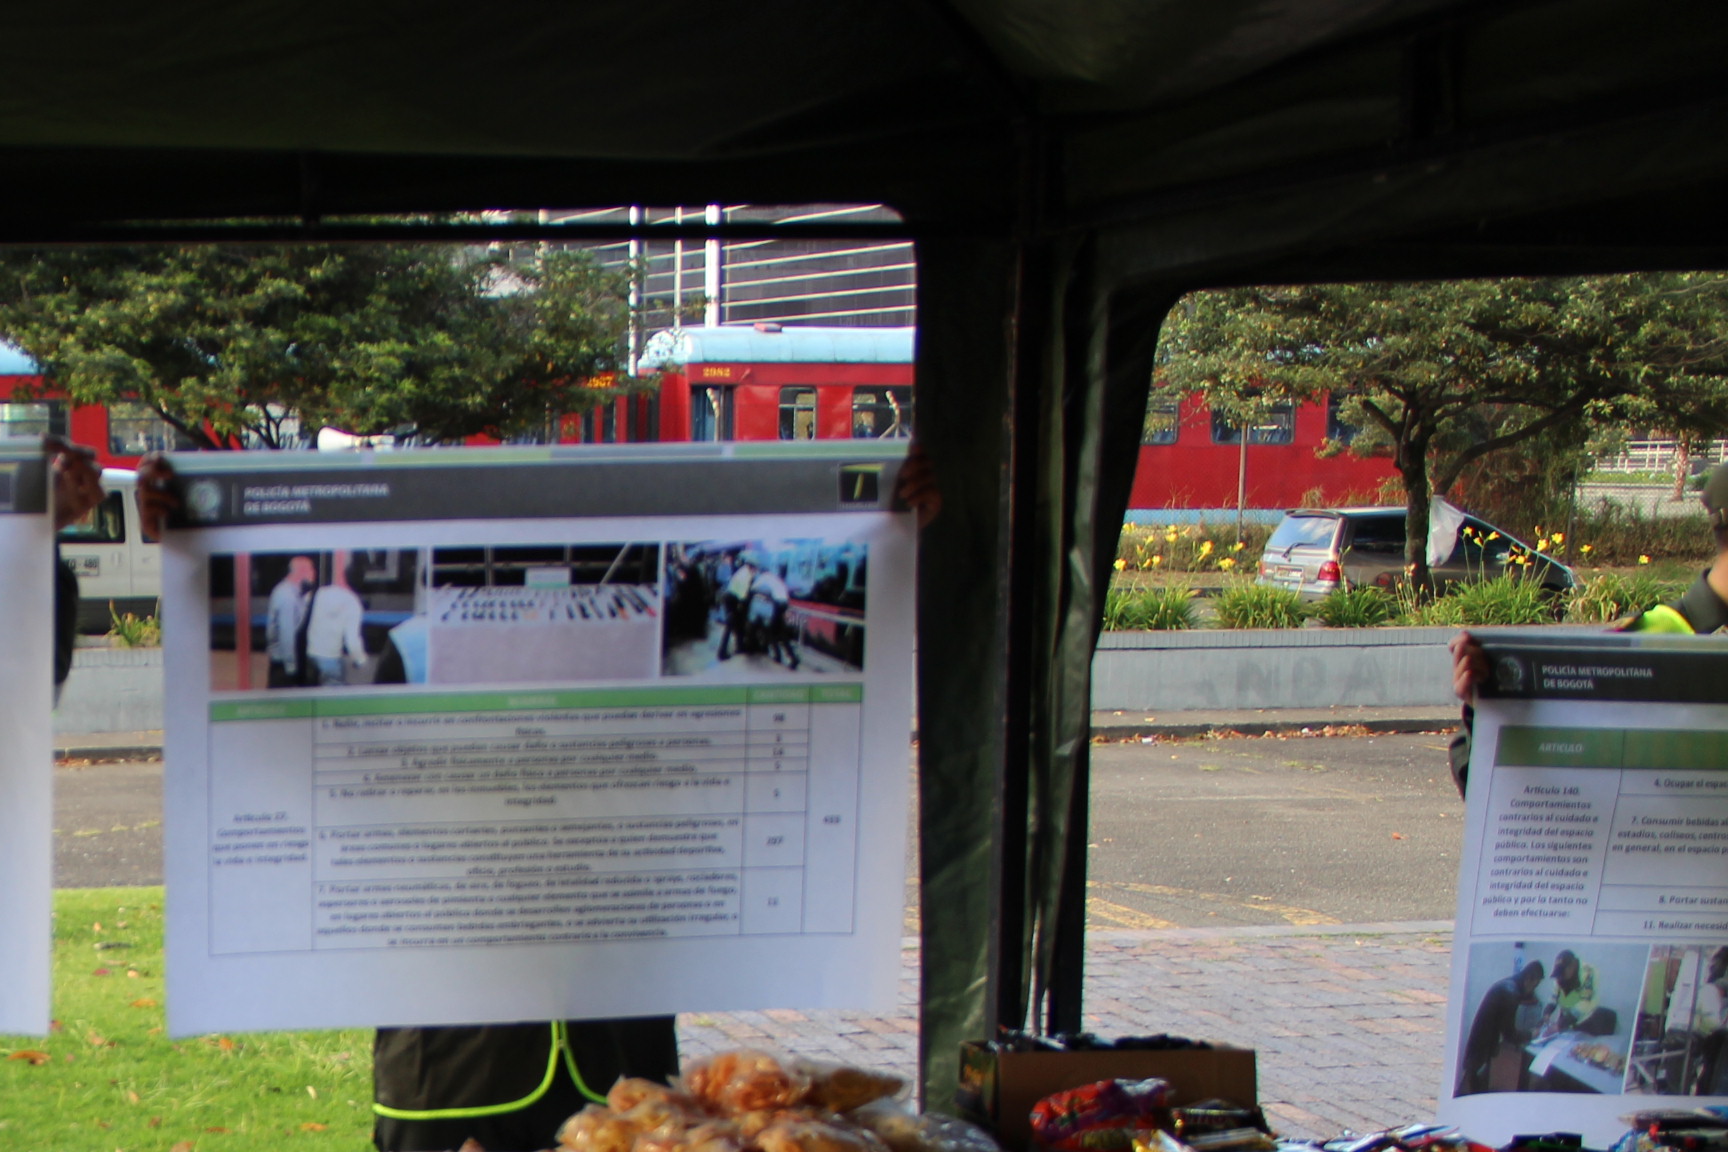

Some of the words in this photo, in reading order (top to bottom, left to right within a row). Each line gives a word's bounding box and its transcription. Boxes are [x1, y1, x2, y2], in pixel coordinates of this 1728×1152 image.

[1542, 664, 1576, 675] POLICÍA
[1578, 667, 1653, 678] METROPOLITANA
[1543, 679, 1556, 688] DE
[1557, 678, 1594, 689] BOGOTÁ
[1664, 779, 1694, 790] Ocupar
[1696, 779, 1704, 788] el
[1510, 799, 1591, 810] Comportamientos
[1499, 814, 1543, 822] contrarios
[1545, 814, 1553, 822] al
[1555, 814, 1591, 823] cuidado
[1641, 817, 1684, 825] Consumir
[1686, 817, 1718, 826] bebidas
[1498, 827, 1542, 838] integridad
[1545, 827, 1558, 837] del
[1560, 829, 1594, 838] espacio
[1618, 830, 1657, 839] estadios,
[1531, 841, 1545, 849] Los
[1546, 841, 1592, 851] siguientes
[1677, 843, 1686, 852] el
[1687, 845, 1719, 855] espacio
[1494, 855, 1570, 865] comportamientos
[1491, 869, 1533, 877] contrarios
[1535, 868, 1543, 877] al
[1545, 868, 1581, 877] cuidado
[1489, 881, 1533, 891] integridad
[1535, 881, 1549, 890] del
[1551, 882, 1584, 892] espacio
[1482, 895, 1512, 905] público
[1520, 897, 1536, 905] por
[1538, 896, 1546, 904] lo
[1548, 896, 1574, 904] tanto
[1669, 896, 1697, 904] Portar
[1493, 908, 1519, 917] deben
[1521, 908, 1570, 918] efectuarse:
[1658, 921, 1692, 930] Realizar
